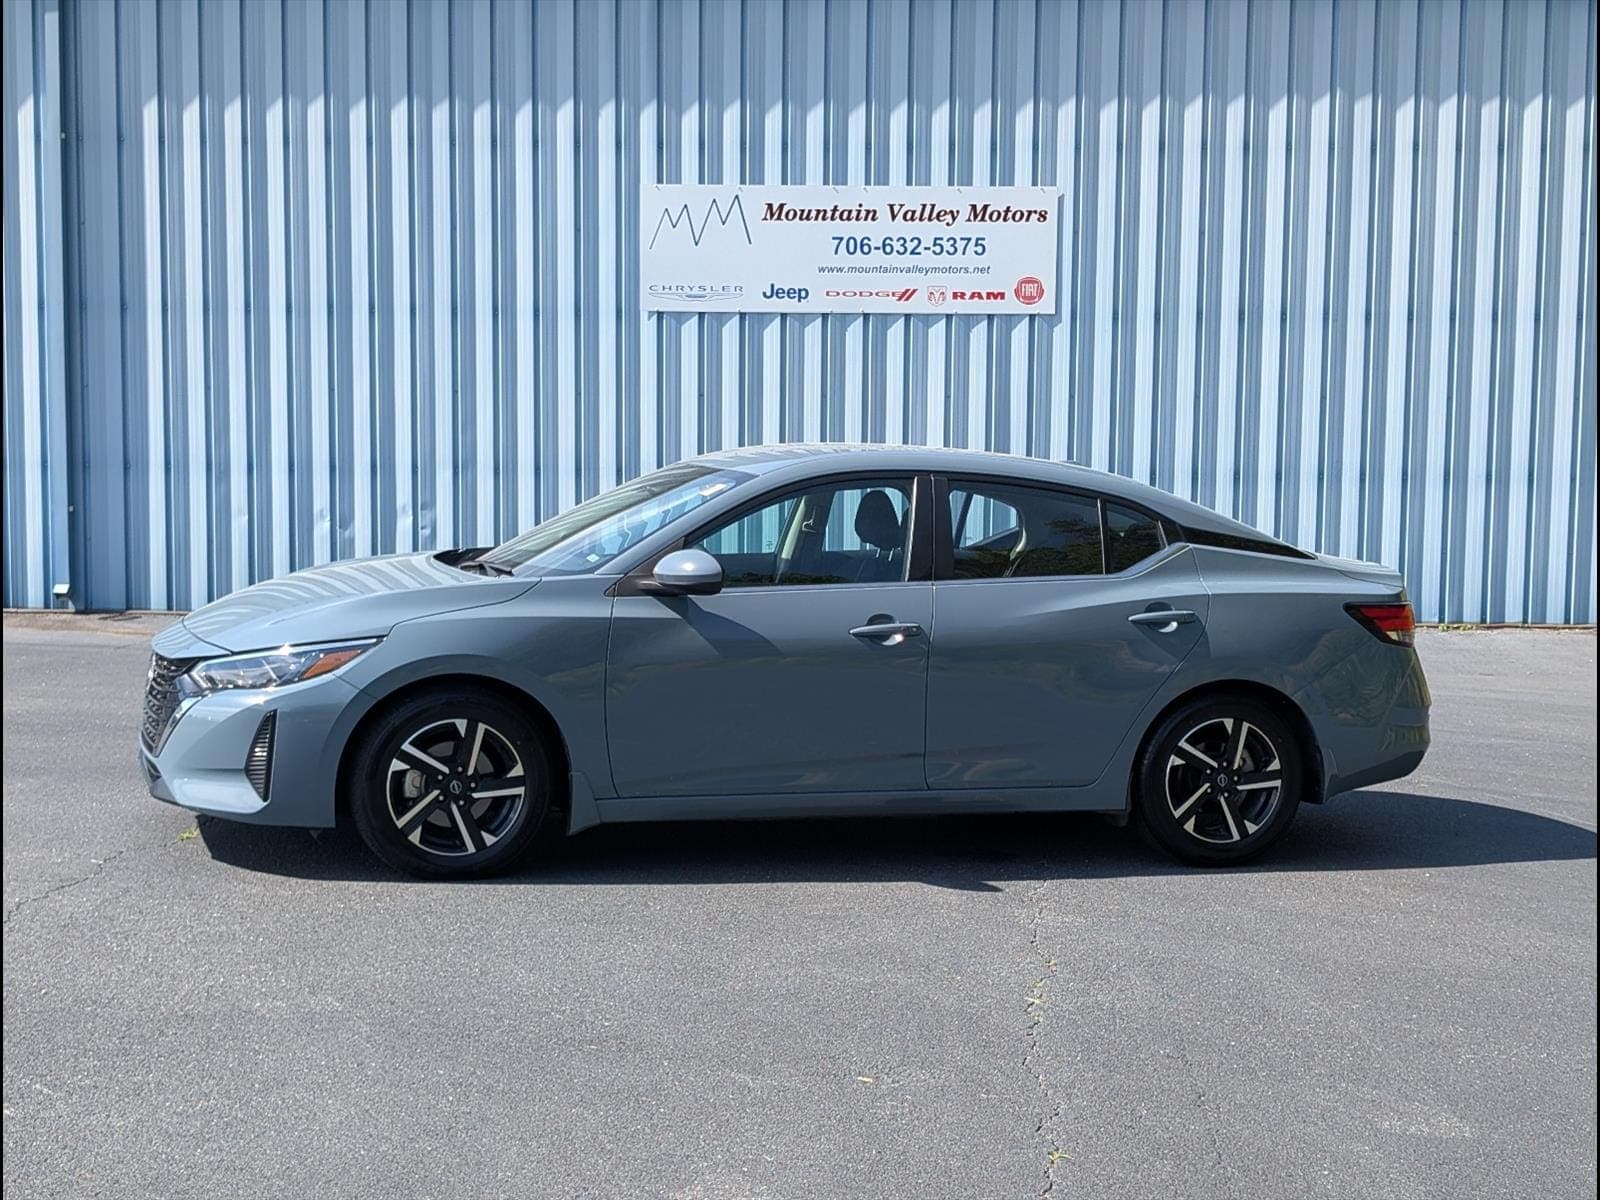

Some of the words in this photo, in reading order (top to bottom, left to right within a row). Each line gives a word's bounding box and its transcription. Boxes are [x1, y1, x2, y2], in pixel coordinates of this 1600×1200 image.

[762, 203, 878, 222] Mountain
[888, 203, 959, 226] Valley
[965, 204, 1048, 223] Motors
[831, 236, 986, 256] 706-632-5375
[817, 264, 991, 277] www.mountainvalleymotors.net
[648, 285, 744, 293] CHRYSLER
[762, 283, 809, 302] Jeep
[825, 290, 903, 298] DODGE
[951, 291, 1006, 300] RAM
[1021, 283, 1038, 297] FIAT
